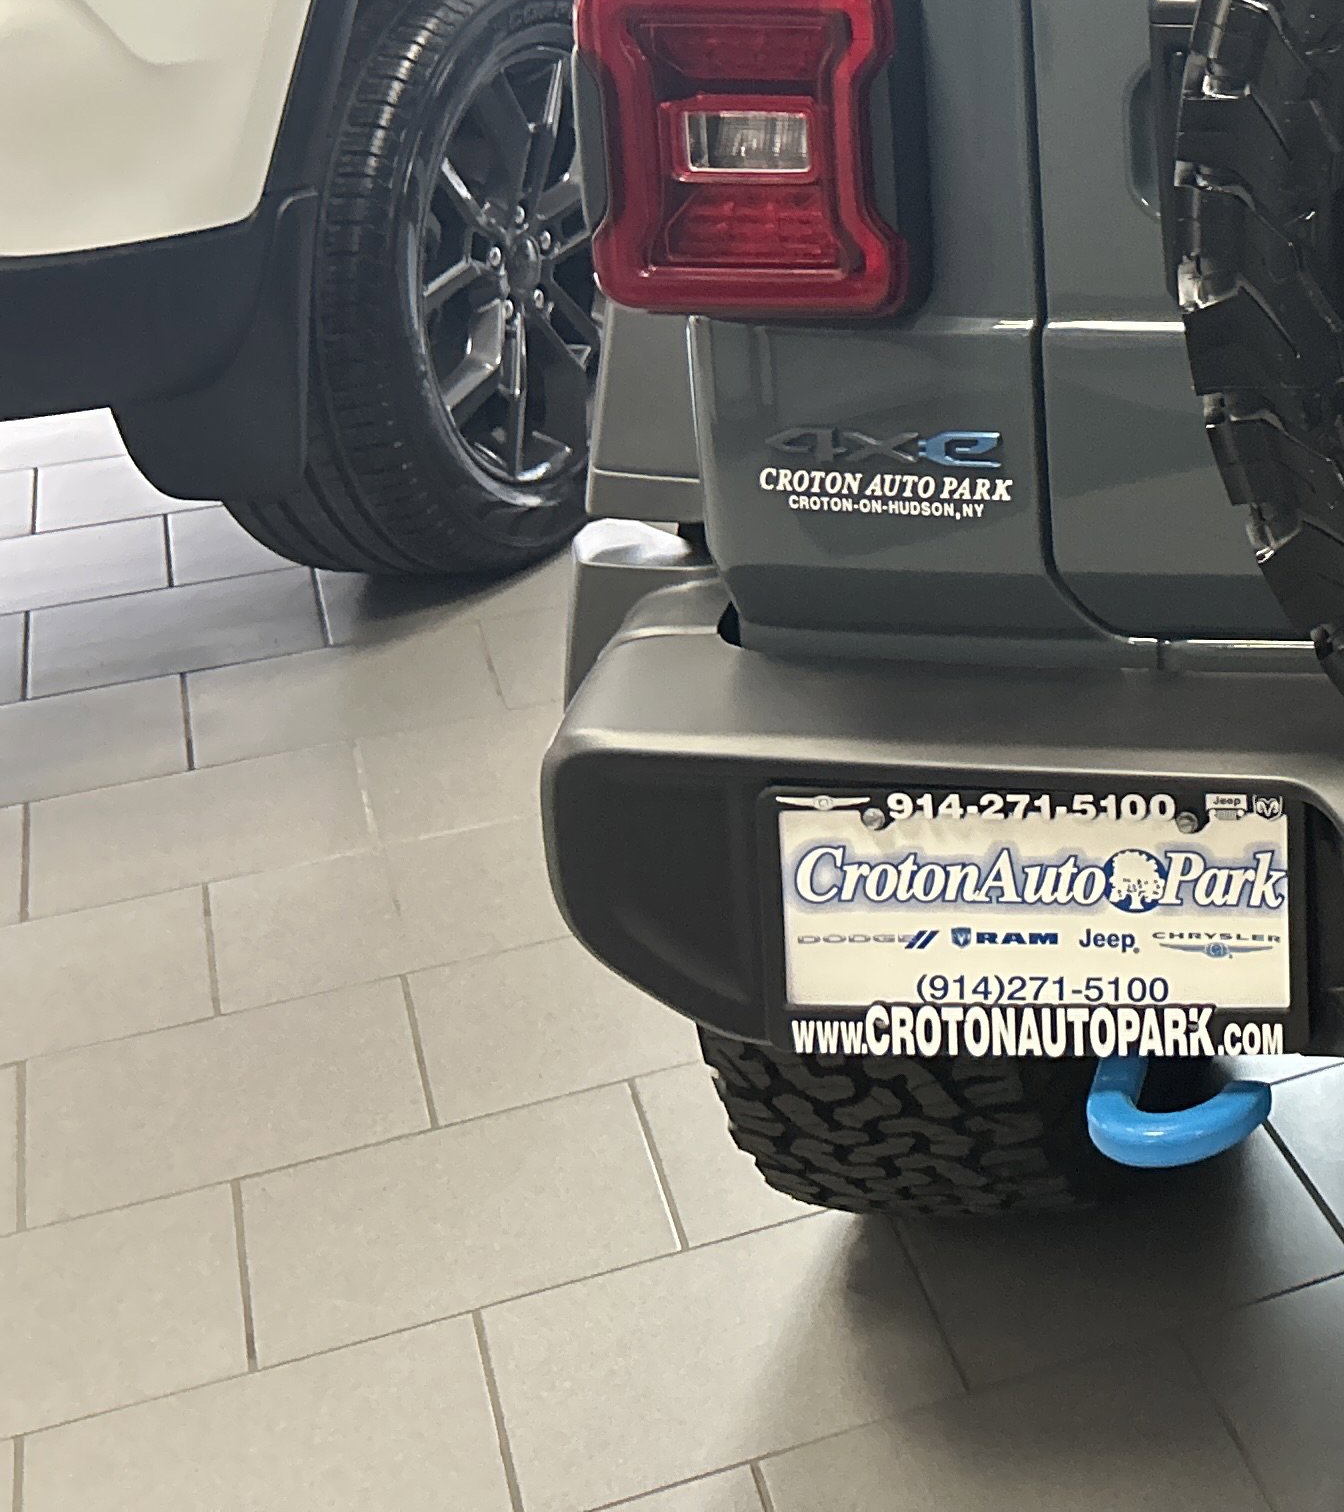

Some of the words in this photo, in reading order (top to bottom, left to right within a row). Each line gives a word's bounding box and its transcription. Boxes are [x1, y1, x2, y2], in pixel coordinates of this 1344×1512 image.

[758, 467, 862, 497] CROTON
[865, 473, 936, 499] AUTO
[939, 476, 1013, 501] PARK
[885, 793, 1177, 821] 914-271-5100
[1213, 796, 1241, 806] Jeep
[1160, 850, 1287, 909] Park
[797, 933, 917, 944] DODGE
[976, 931, 1059, 945] RAM
[1078, 928, 1136, 954] Jeep
[1152, 931, 1282, 943] CHRYSLER
[917, 974, 1169, 1004] (914)271-5100
